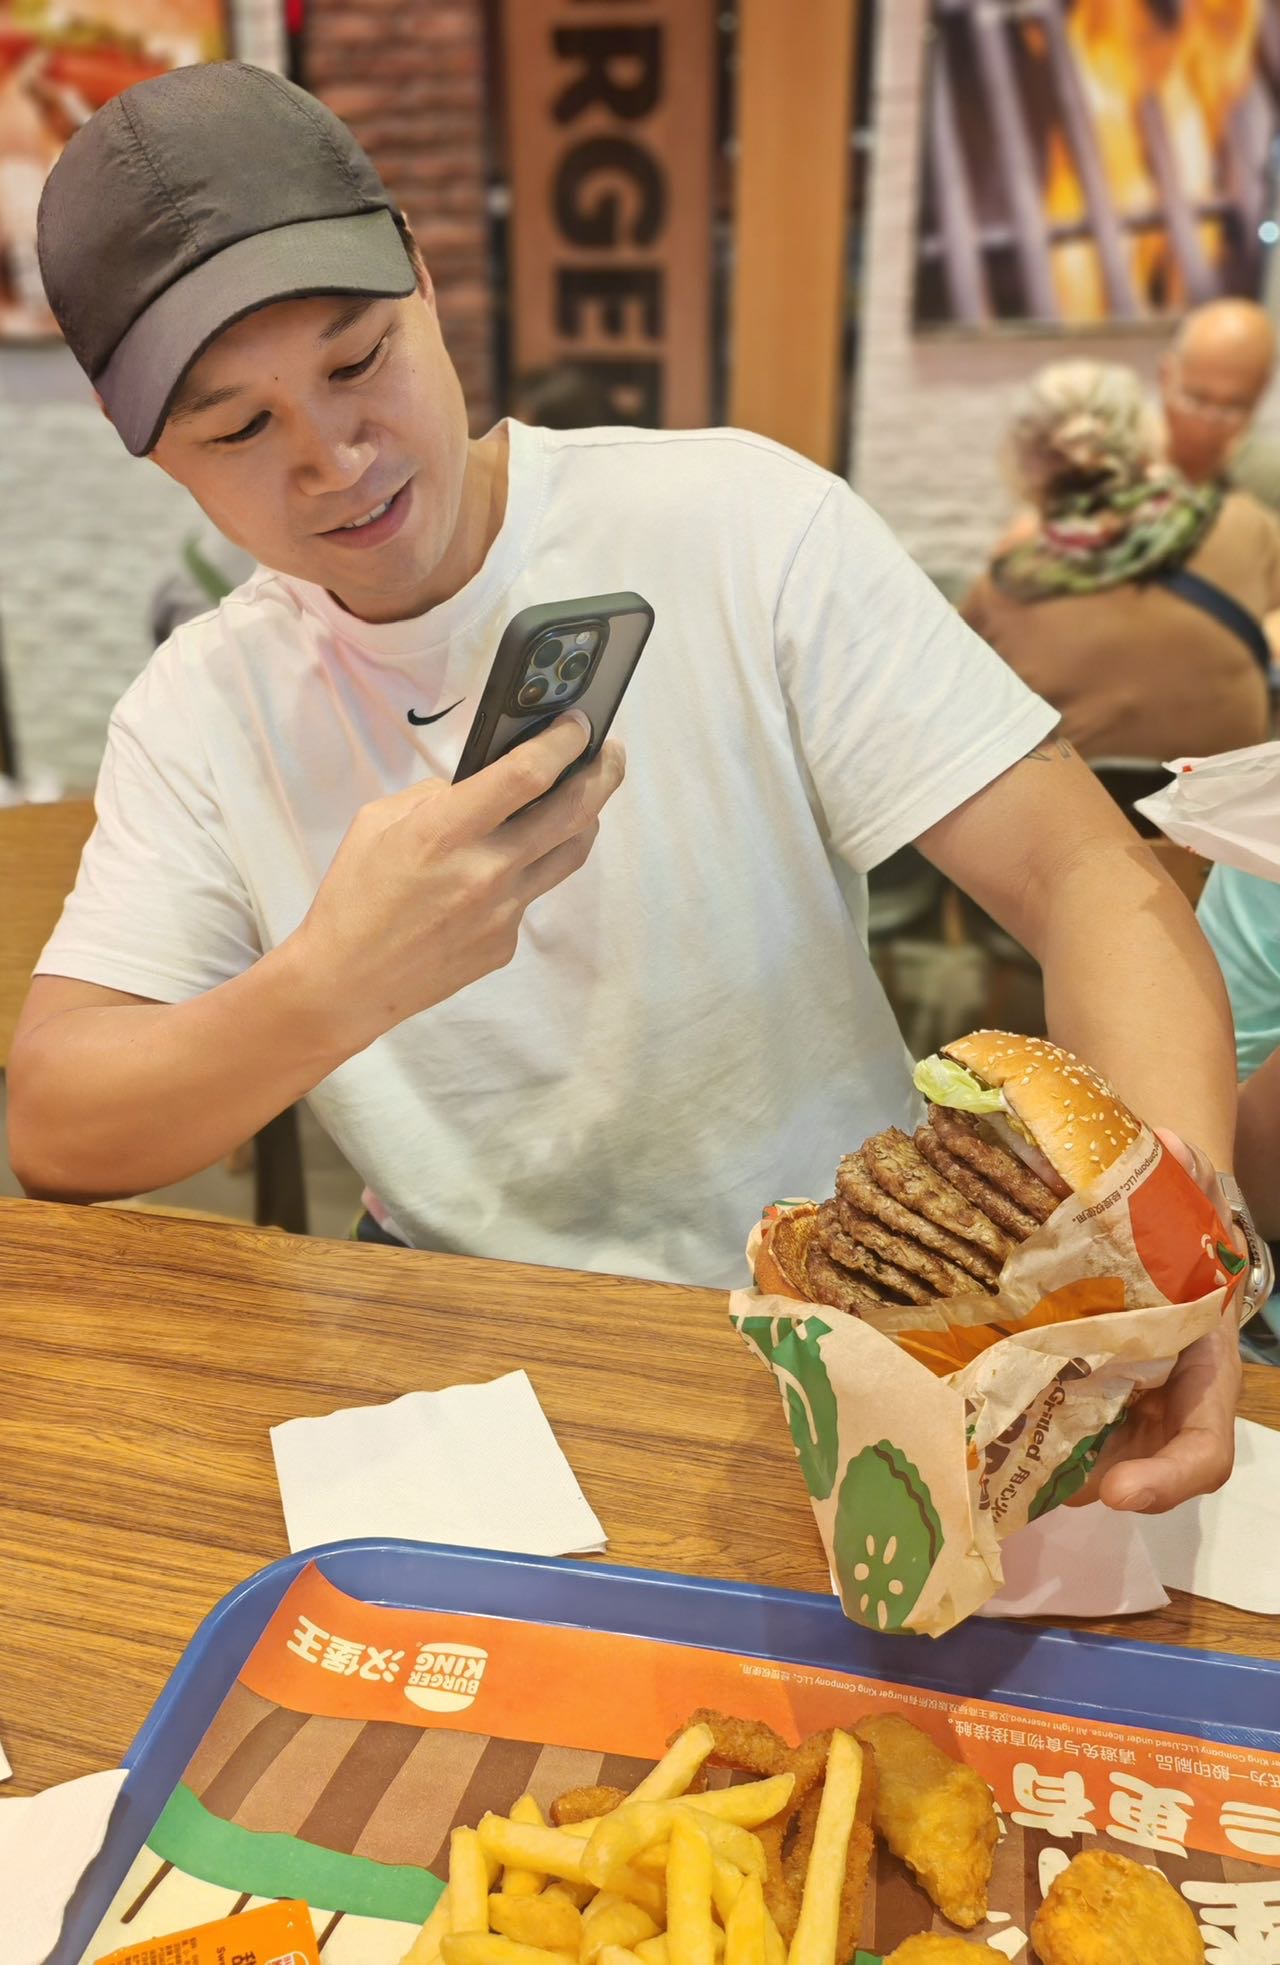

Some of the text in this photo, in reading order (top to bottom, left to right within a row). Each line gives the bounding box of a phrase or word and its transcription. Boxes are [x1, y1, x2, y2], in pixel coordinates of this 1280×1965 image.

[286, 1615, 406, 1683] 汉堡王
[414, 1652, 487, 1680] KING
[408, 1670, 481, 1695] BURGER
[814, 1675, 857, 1693] Company
[857, 1683, 877, 1697] King
[1052, 1722, 1075, 1733] right
[1127, 1735, 1154, 1745] under
[1200, 1746, 1246, 1763] Company
[1247, 1754, 1270, 1767] King
[988, 1762, 1195, 1859] 更有
